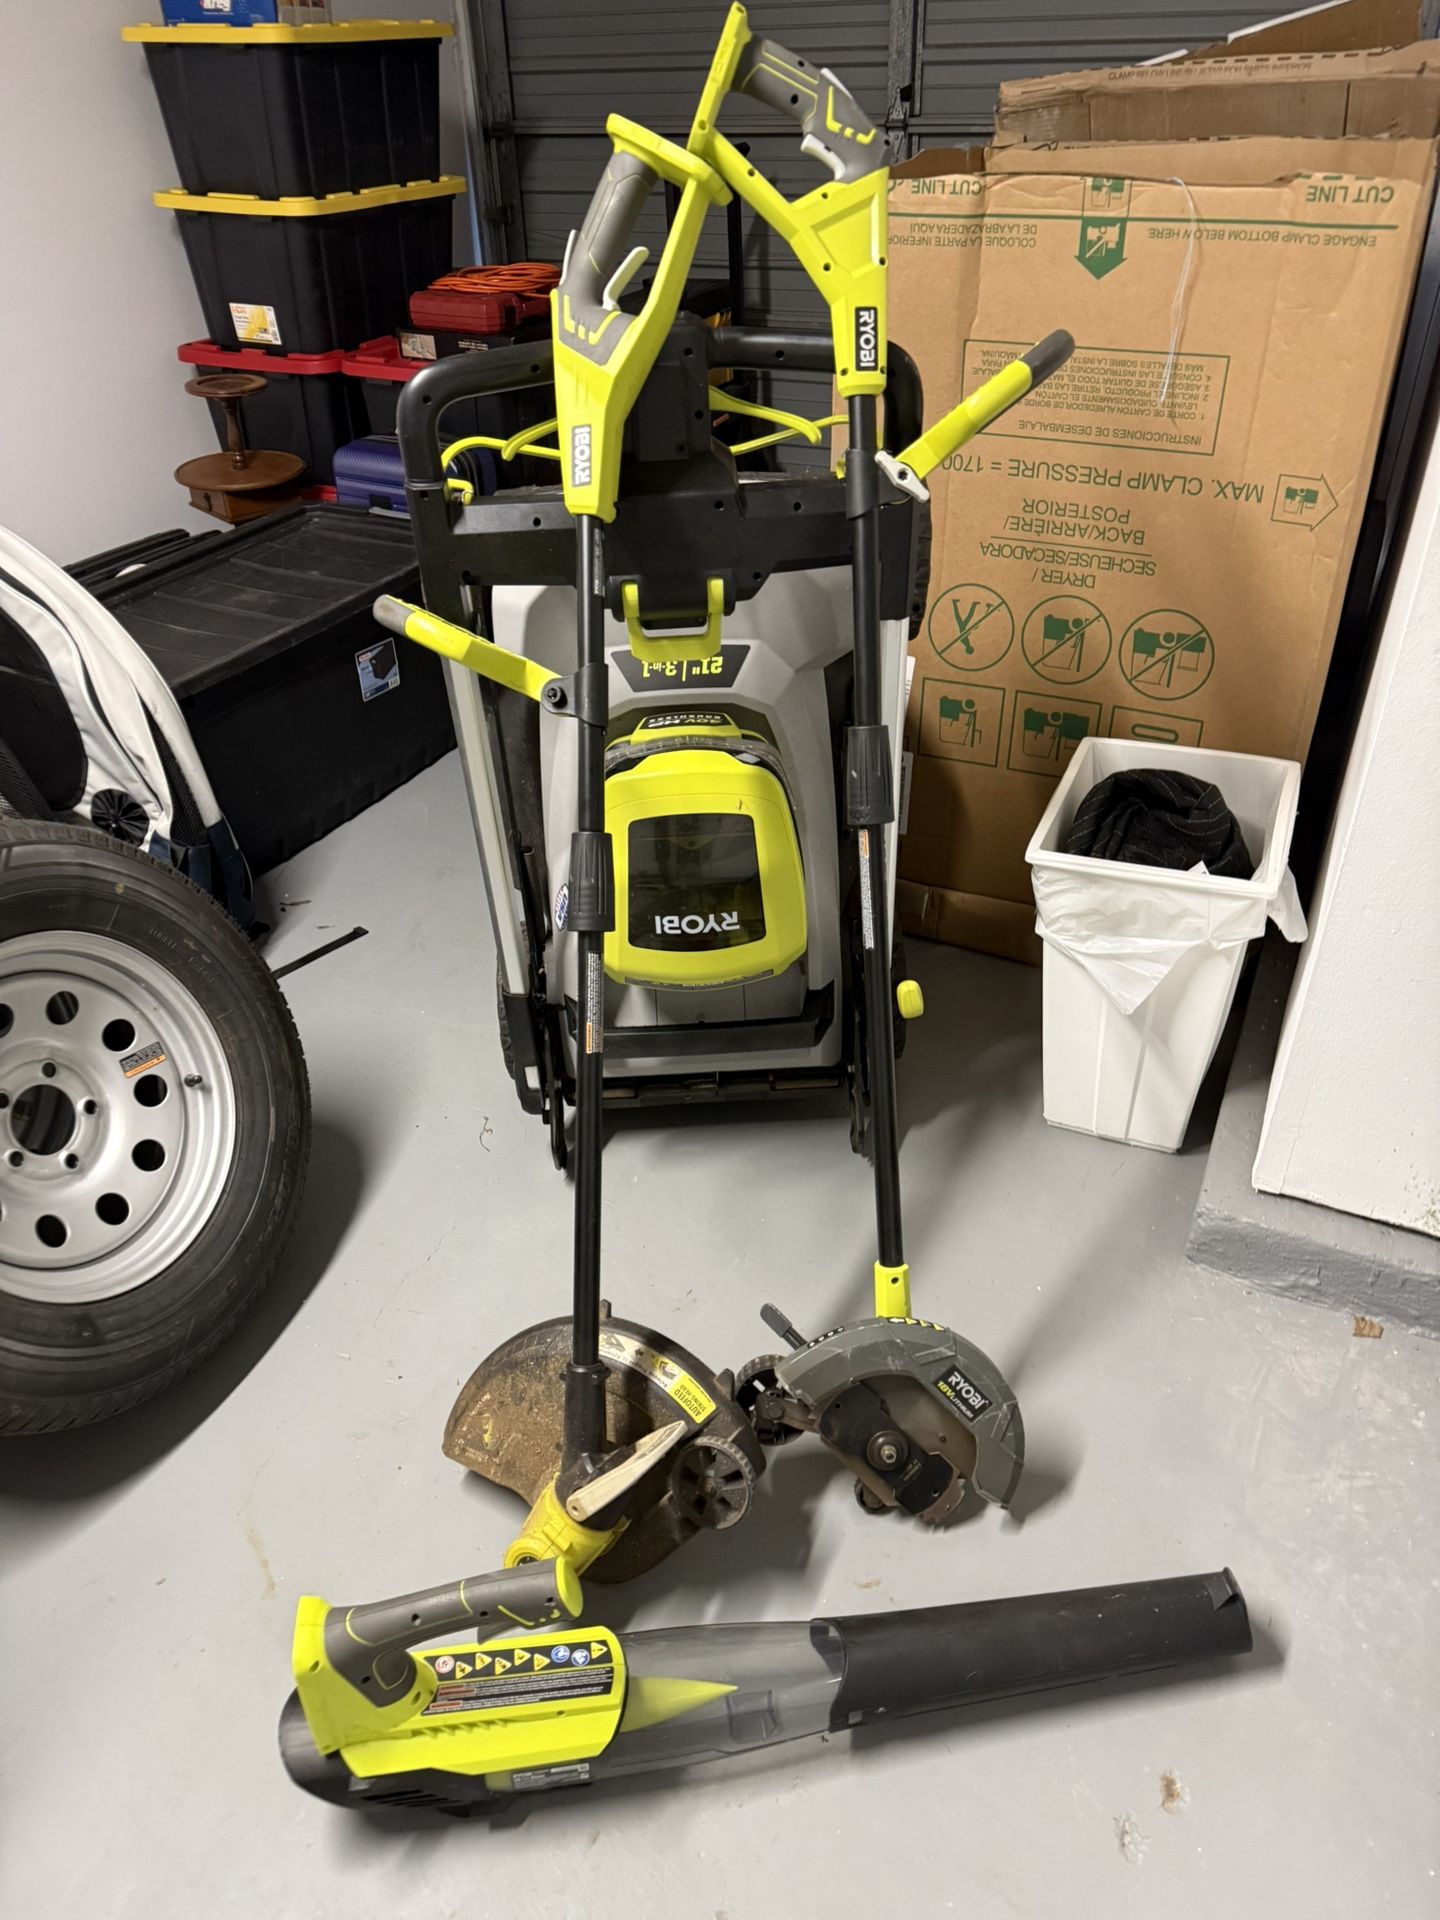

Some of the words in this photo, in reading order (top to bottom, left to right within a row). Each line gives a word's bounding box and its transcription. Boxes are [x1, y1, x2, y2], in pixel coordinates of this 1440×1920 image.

[911, 178, 945, 195] LINE
[949, 180, 982, 197] CUT
[1305, 185, 1349, 202] LINE
[1352, 187, 1395, 204] CUT
[934, 222, 1007, 234] ABRAZADERA
[1007, 223, 1021, 234] LA
[1022, 224, 1038, 235] DE
[1148, 227, 1181, 240] HERE
[1228, 230, 1280, 243] BOTTOM
[934, 236, 968, 247] PARTE
[969, 236, 982, 247] LA
[984, 236, 1037, 248] COLOQUE
[1282, 233, 1320, 246] CLAMP
[1323, 234, 1377, 248] ENGAGE
[859, 309, 875, 367] RYOBI
[1053, 401, 1064, 409] DE
[1066, 403, 1116, 413] ALREDEDOR
[1167, 410, 1197, 420] CORTE
[1017, 420, 1093, 437] DESEMBALAJE
[1094, 427, 1110, 438] DE
[1113, 428, 1202, 446] INSTRUCCIONES
[574, 426, 591, 485] RYOBI
[1008, 459, 1122, 487] PRESSURE
[1127, 471, 1204, 496] CLAMP
[1212, 479, 1265, 504] MAX.
[1023, 498, 1131, 525] POSTERIOR
[1002, 515, 1146, 545] BACK/ARRIÈRE/
[979, 541, 1157, 577] SECHEUSE/SECADORA
[1041, 568, 1096, 590] DRYER
[655, 911, 741, 935] RYOBI
[679, 1384, 693, 1397] HEAD
[948, 1371, 985, 1410] RYOBI
[673, 1388, 702, 1417] AUTOFEED
[689, 1395, 707, 1412] STRING
